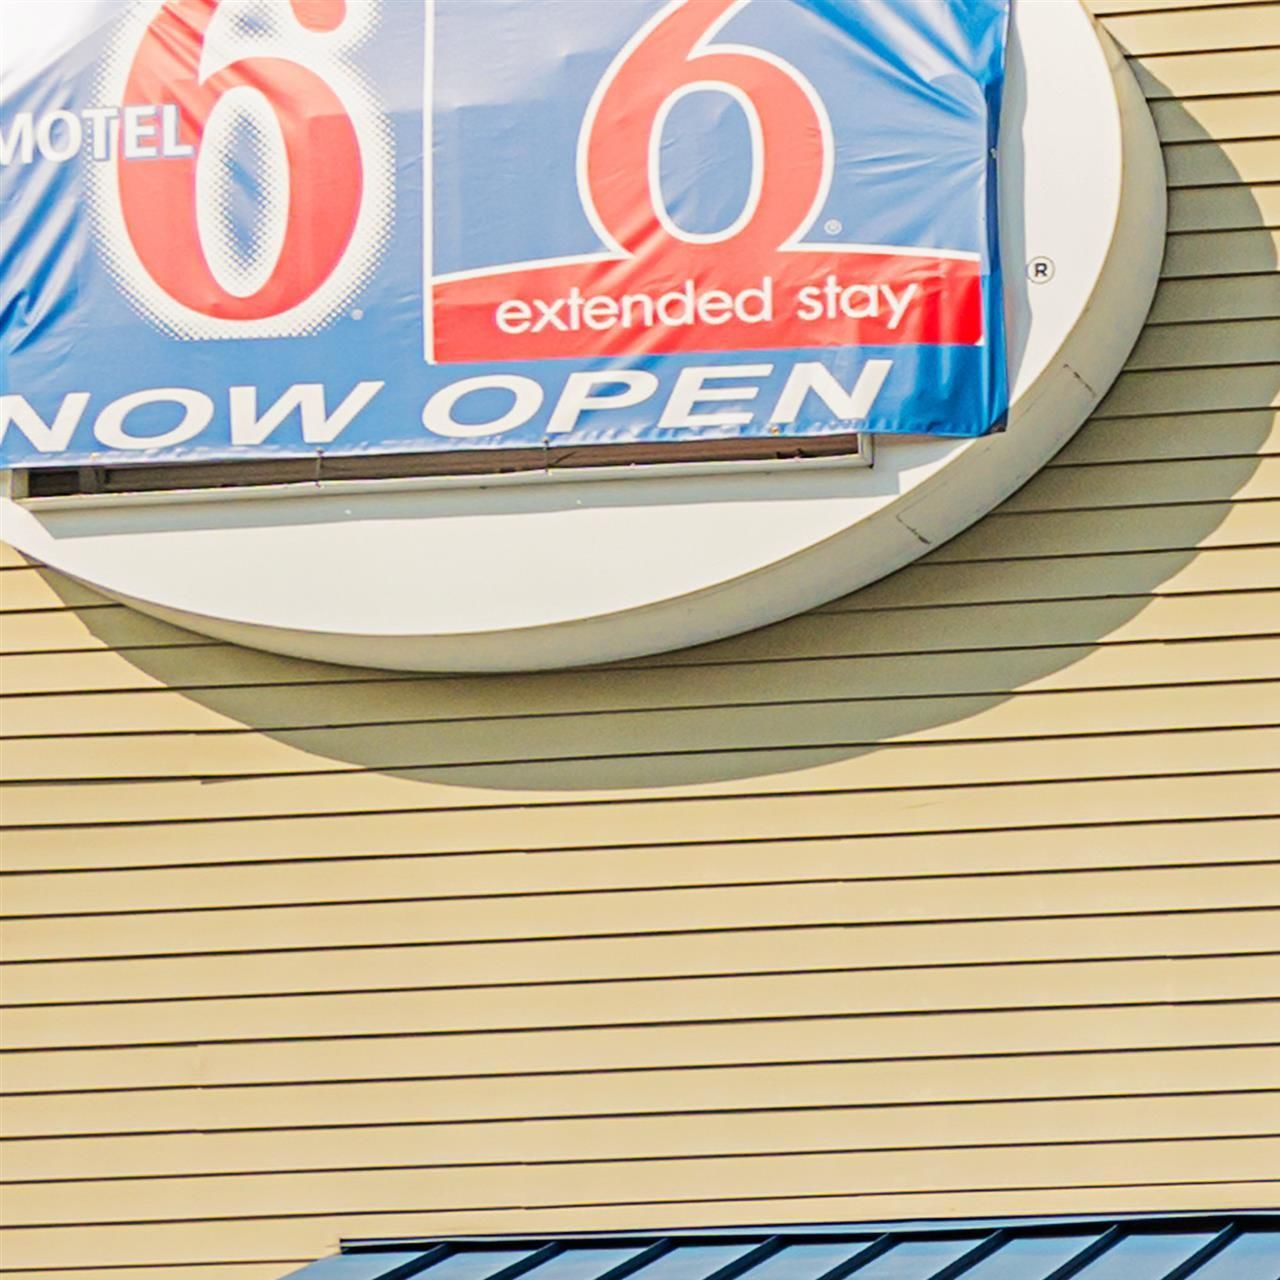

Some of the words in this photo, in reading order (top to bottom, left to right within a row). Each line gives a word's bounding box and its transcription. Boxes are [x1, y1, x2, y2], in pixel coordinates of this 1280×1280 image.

[0, 104, 194, 165] MOTEL
[112, 0, 367, 326] 6
[577, 0, 835, 262] 6
[496, 276, 773, 335] extended
[798, 279, 918, 328] stay
[0, 380, 386, 453] NOW
[421, 359, 893, 438] OPEN
